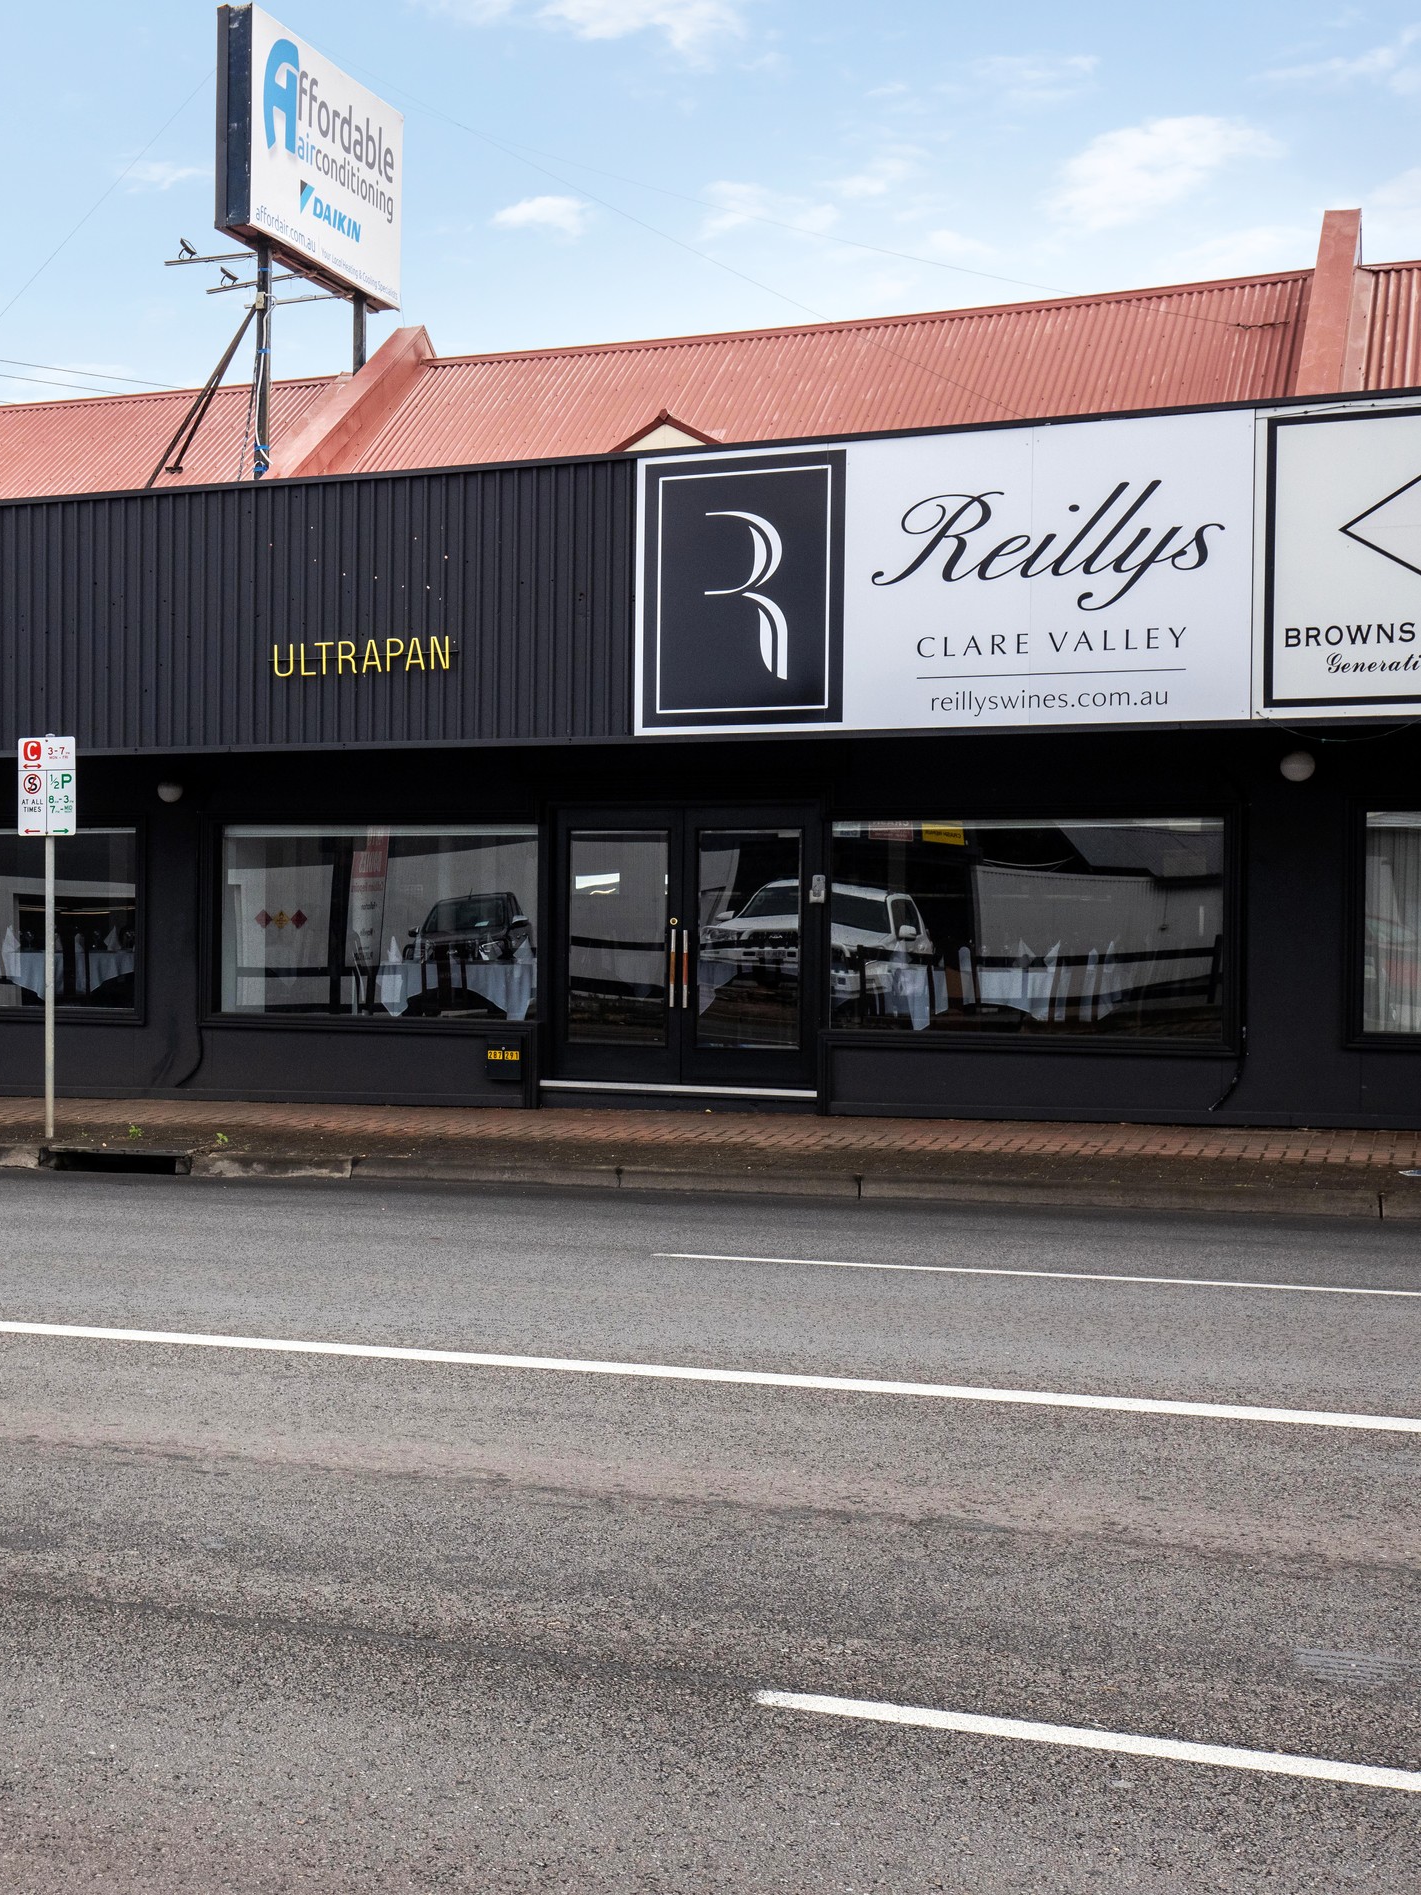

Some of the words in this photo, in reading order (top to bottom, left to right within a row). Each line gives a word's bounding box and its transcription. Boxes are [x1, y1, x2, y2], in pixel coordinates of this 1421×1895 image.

[264, 38, 394, 184] Affordable
[297, 135, 394, 224] airconditioning
[256, 205, 316, 252] affordair.com.au
[313, 196, 361, 243] DAIKIN
[871, 479, 1226, 612] Reillys
[274, 636, 450, 677] ULTRAPAN
[916, 632, 1030, 659] CLARE
[1048, 626, 1188, 654] VALLEY
[1284, 622, 1416, 648] BROWNS
[1326, 652, 1421, 674] Generati
[931, 685, 1170, 718] reillyswines.com.au
